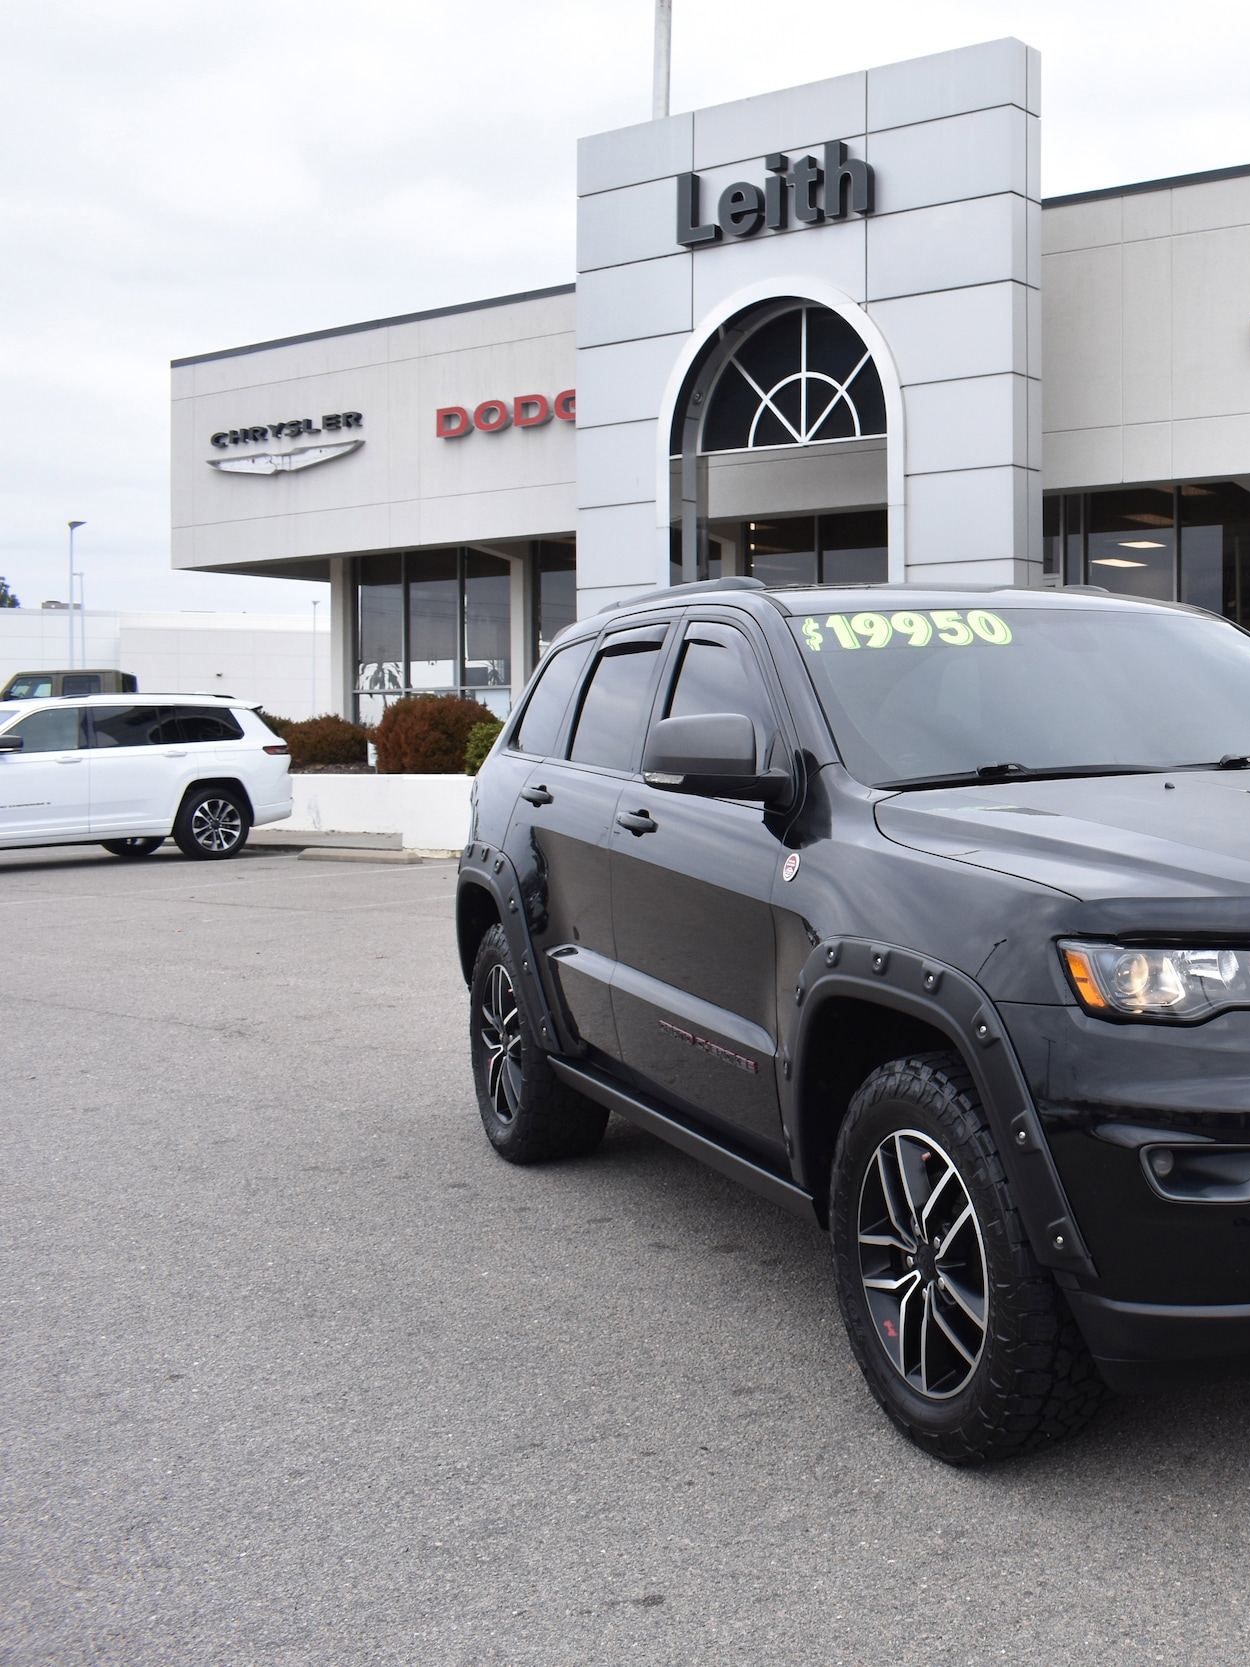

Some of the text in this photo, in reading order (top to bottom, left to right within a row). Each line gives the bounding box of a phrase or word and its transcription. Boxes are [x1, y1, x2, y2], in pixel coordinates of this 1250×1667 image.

[677, 139, 875, 247] Leith
[210, 411, 363, 449] CHRYSLER
[802, 610, 1012, 651] $19950
